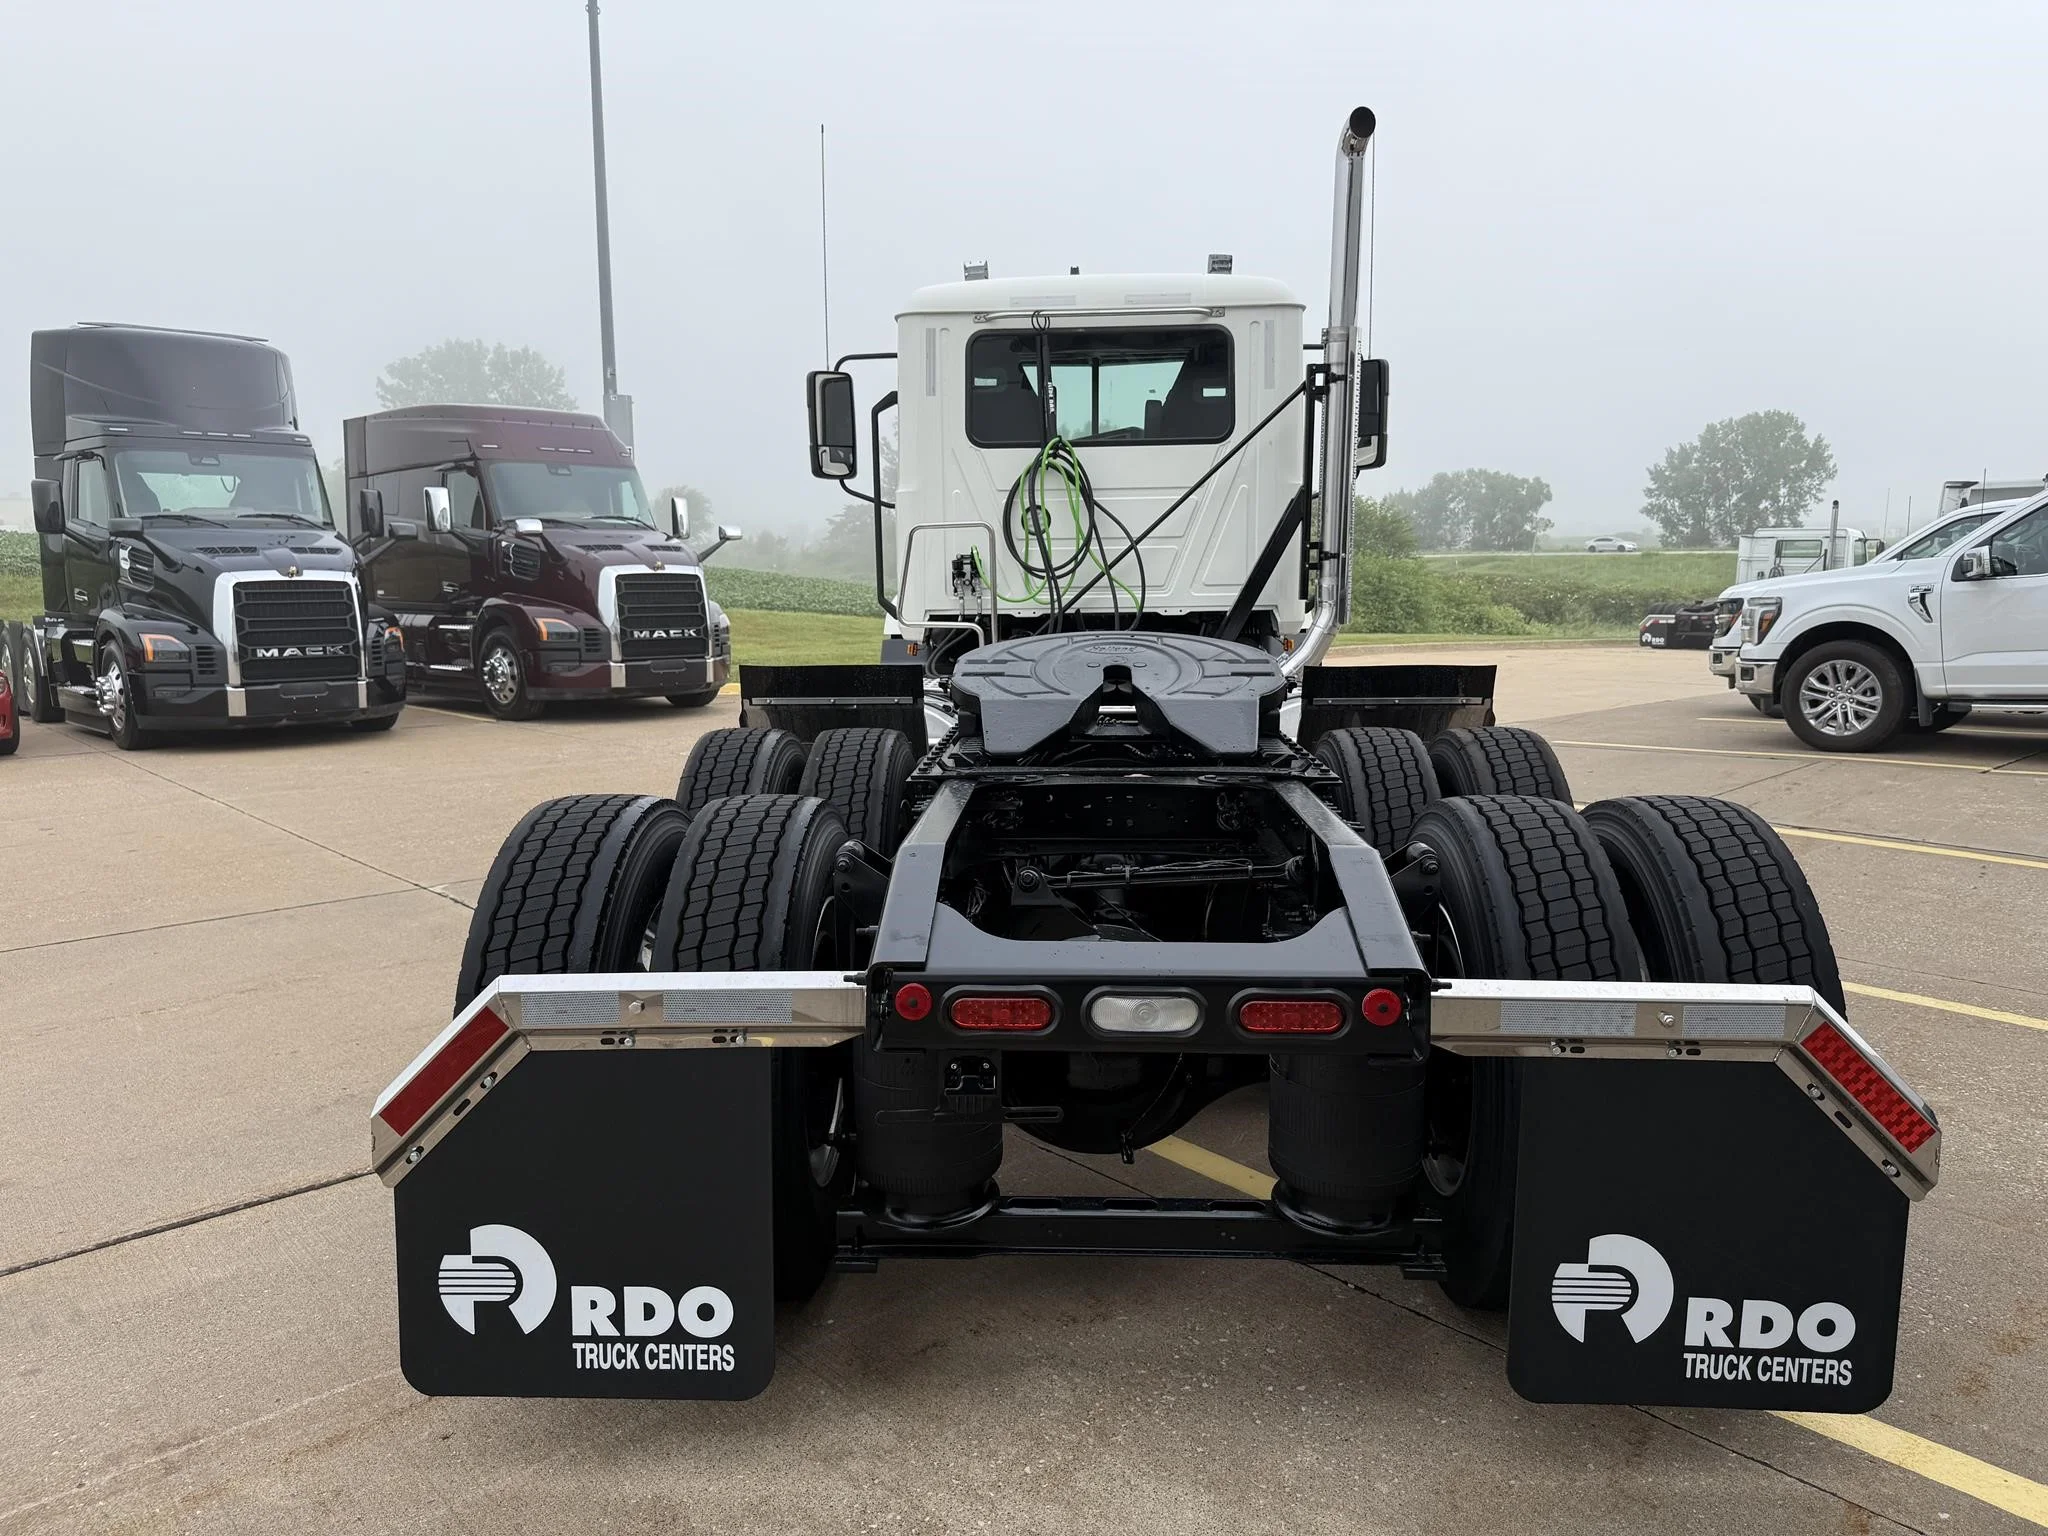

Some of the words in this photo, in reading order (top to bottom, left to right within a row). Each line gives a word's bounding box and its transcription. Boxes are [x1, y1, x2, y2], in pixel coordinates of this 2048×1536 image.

[633, 629, 697, 638] MACK
[256, 645, 345, 658] MACK
[571, 1285, 734, 1338] RDO
[1684, 1296, 1856, 1353] RDO
[572, 1342, 640, 1370] TRUCK
[644, 1342, 735, 1372] CENTERS
[1683, 1352, 1753, 1381] TRUCK
[1757, 1355, 1853, 1386] CENTERS
